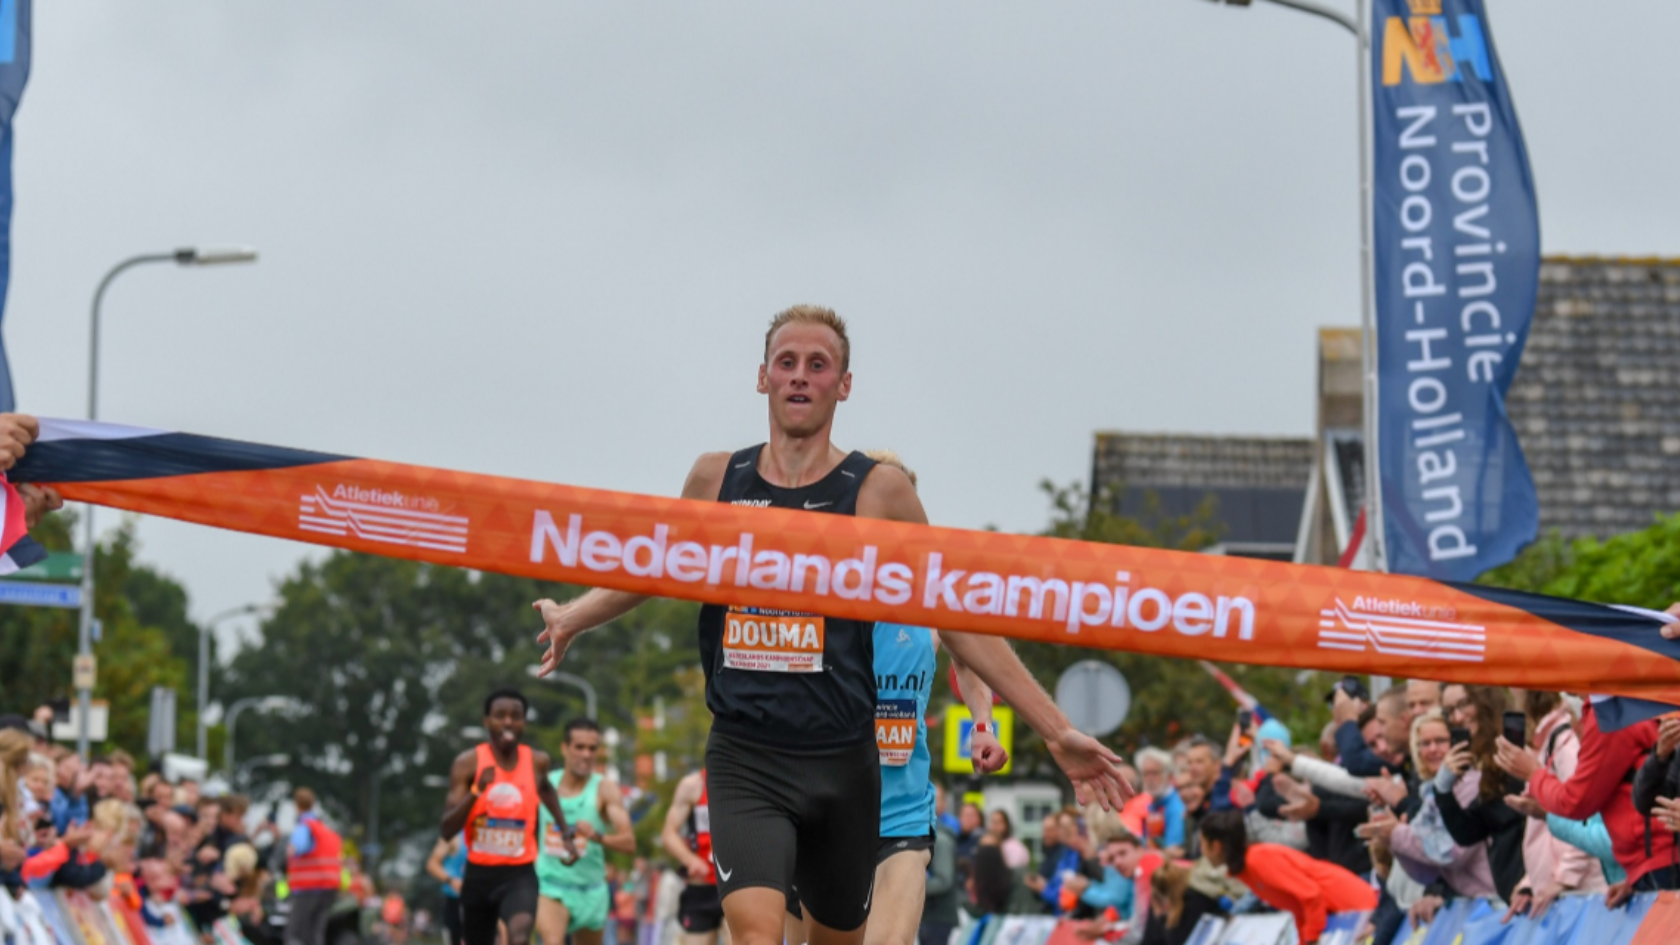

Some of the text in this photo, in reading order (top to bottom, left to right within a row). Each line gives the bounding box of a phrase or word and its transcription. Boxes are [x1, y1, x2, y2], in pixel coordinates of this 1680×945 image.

[1451, 102, 1516, 383] Provincie
[1396, 105, 1477, 560] Noord-Holland
[529, 509, 1255, 640] Nederlands kampioen
[728, 618, 820, 649] DOUMA
[1352, 595, 1457, 621] Atletiekunie
